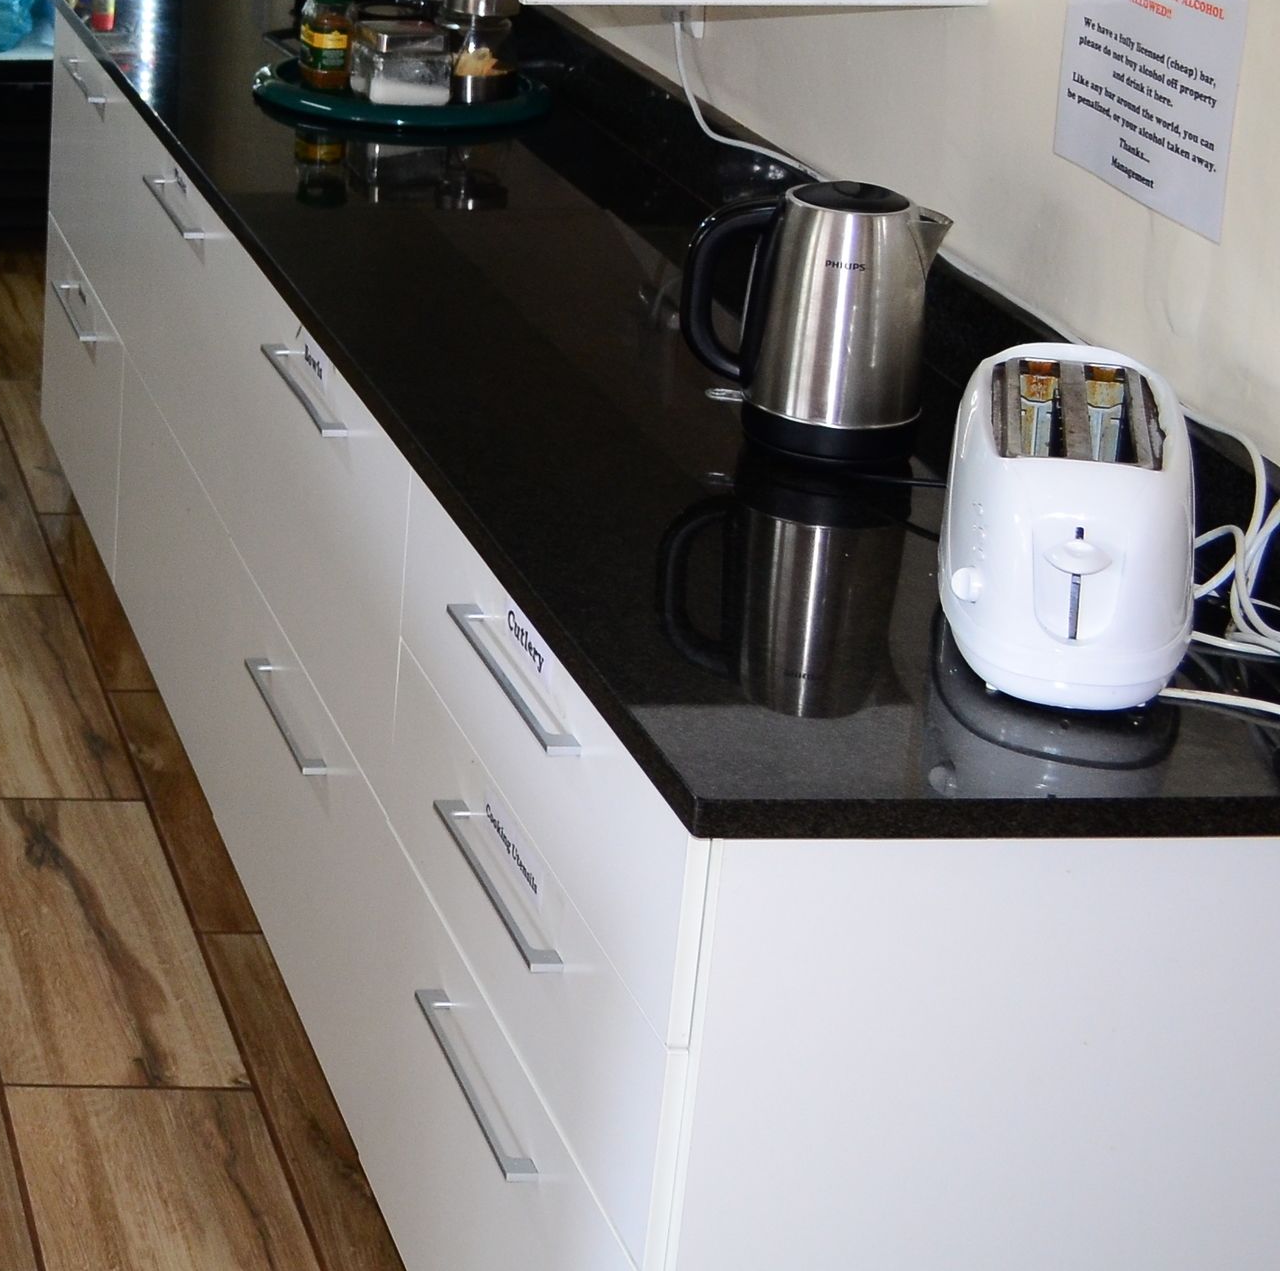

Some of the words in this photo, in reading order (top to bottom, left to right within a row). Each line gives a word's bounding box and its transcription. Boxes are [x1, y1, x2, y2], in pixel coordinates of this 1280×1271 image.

[1078, 36, 1102, 53] please
[1103, 45, 1111, 57] do
[1112, 51, 1124, 64] not
[1125, 55, 1138, 72] buy
[1139, 64, 1165, 85] alcohol
[1166, 77, 1178, 90] off
[1179, 83, 1217, 108] property
[1084, 16, 1096, 31] We
[1097, 22, 1113, 38] have
[1119, 33, 1135, 51] fully
[1136, 42, 1165, 64] licensed
[1166, 56, 1198, 81] (cheap)
[1199, 70, 1217, 89] bar,
[1072, 71, 1089, 88] Like
[1090, 80, 1103, 96] any
[1104, 86, 1116, 101] bar
[1116, 96, 1141, 116] around
[1141, 108, 1154, 123] the
[1155, 115, 1181, 137] world,
[1183, 129, 1198, 143] you
[1200, 138, 1214, 151] can
[1112, 70, 1125, 83] and
[1126, 76, 1145, 95] drink
[1146, 86, 1153, 98] it
[1154, 89, 1174, 108] here.
[1067, 87, 1076, 100] be
[1112, 113, 1121, 123] or
[1121, 117, 1137, 133] your
[1138, 127, 1165, 148] alcohol
[1166, 140, 1190, 160] taken
[1191, 153, 1217, 173] away.
[1111, 155, 1154, 189] Management
[825, 259, 866, 272] PHILIPS
[304, 342, 322, 380] Bowls
[506, 608, 546, 674] Cutlery
[484, 802, 511, 859] Cooking
[510, 843, 539, 896] Utensils
